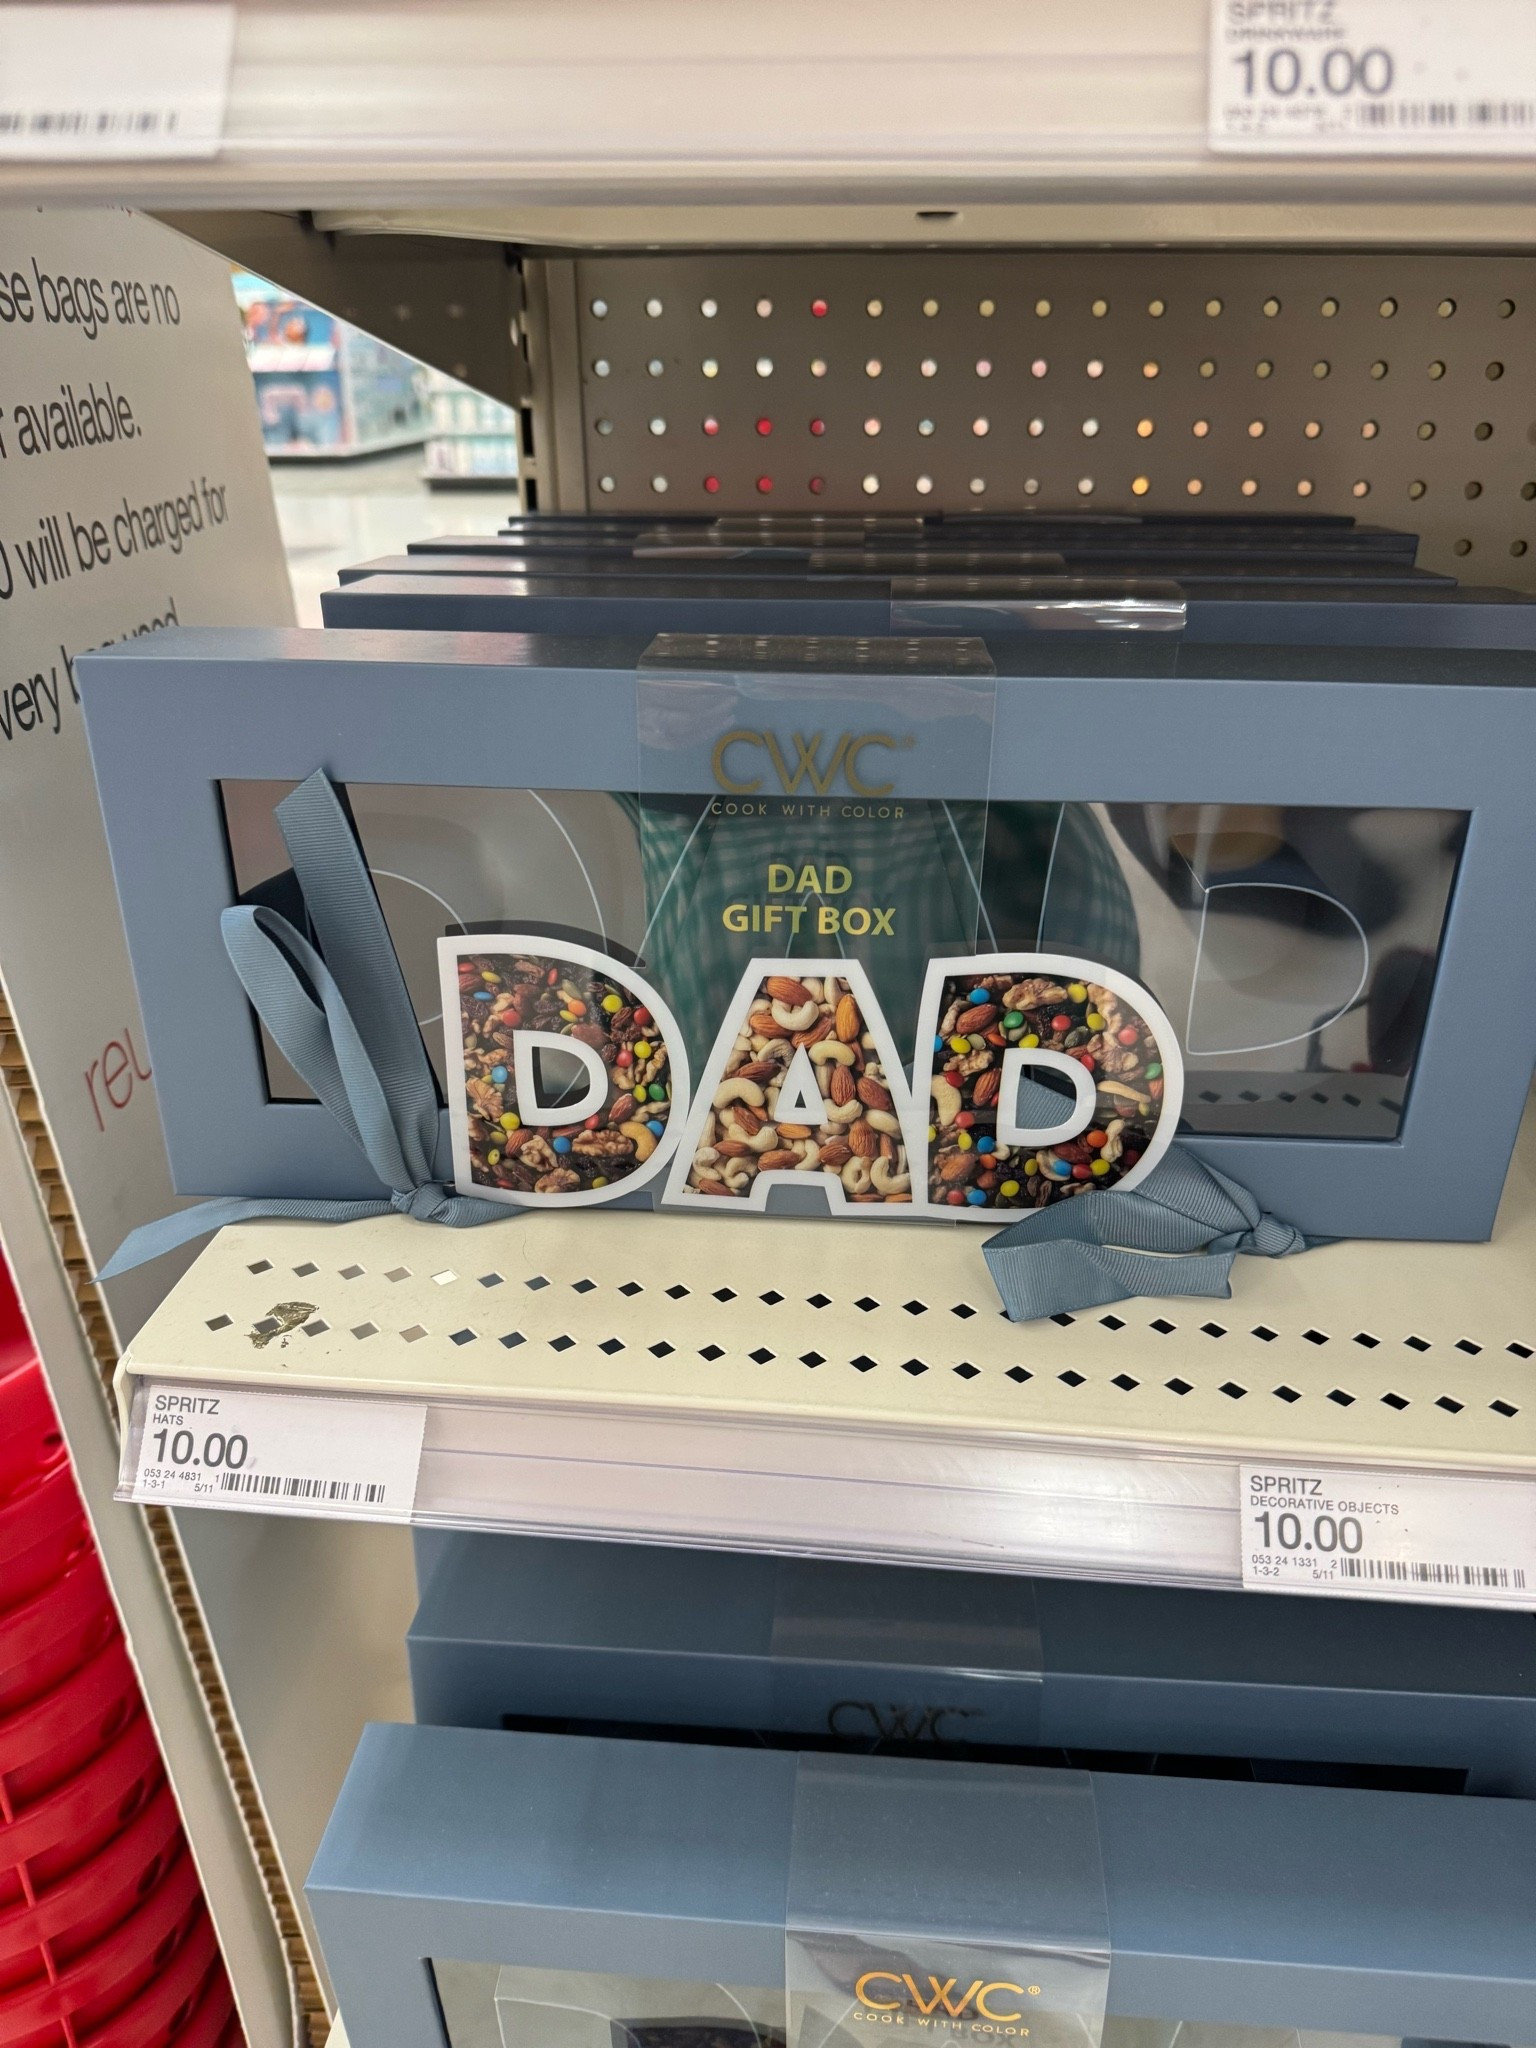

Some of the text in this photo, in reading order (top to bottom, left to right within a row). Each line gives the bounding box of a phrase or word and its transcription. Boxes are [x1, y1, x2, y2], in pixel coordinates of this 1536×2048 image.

[1234, 47, 1394, 97] 10.00
[31, 256, 109, 340] bags
[111, 280, 150, 325] are
[150, 283, 181, 325] no
[14, 381, 142, 456] available.
[14, 515, 71, 589] will
[67, 512, 111, 572] be
[114, 480, 204, 555] charged
[201, 476, 229, 527] for
[711, 802, 905, 819] COOK WITH COLOR
[768, 864, 852, 895] DAD
[722, 904, 896, 936] GIFT BOX
[437, 934, 1184, 1222] DAD
[155, 1394, 220, 1415] SPRITZ
[152, 1413, 184, 1426] HATS
[153, 1428, 248, 1469] 10.00
[142, 1479, 213, 1493] 1-3-1 5/11
[143, 1468, 161, 1479] 053
[164, 1470, 176, 1480] 24
[178, 1471, 202, 1482] 4831
[1250, 1475, 1323, 1496] SPRITZ
[1250, 1495, 1399, 1515] DECORATIVE OBJECTS
[1254, 1511, 1363, 1553] 10.00
[1252, 1554, 1272, 1565] 053
[1275, 1555, 1288, 1566] 24
[1292, 1557, 1317, 1568] 1331
[1253, 1566, 1334, 1580] 1-3-2 5/11
[853, 2012, 1030, 2037] COOK WITH COLOR
